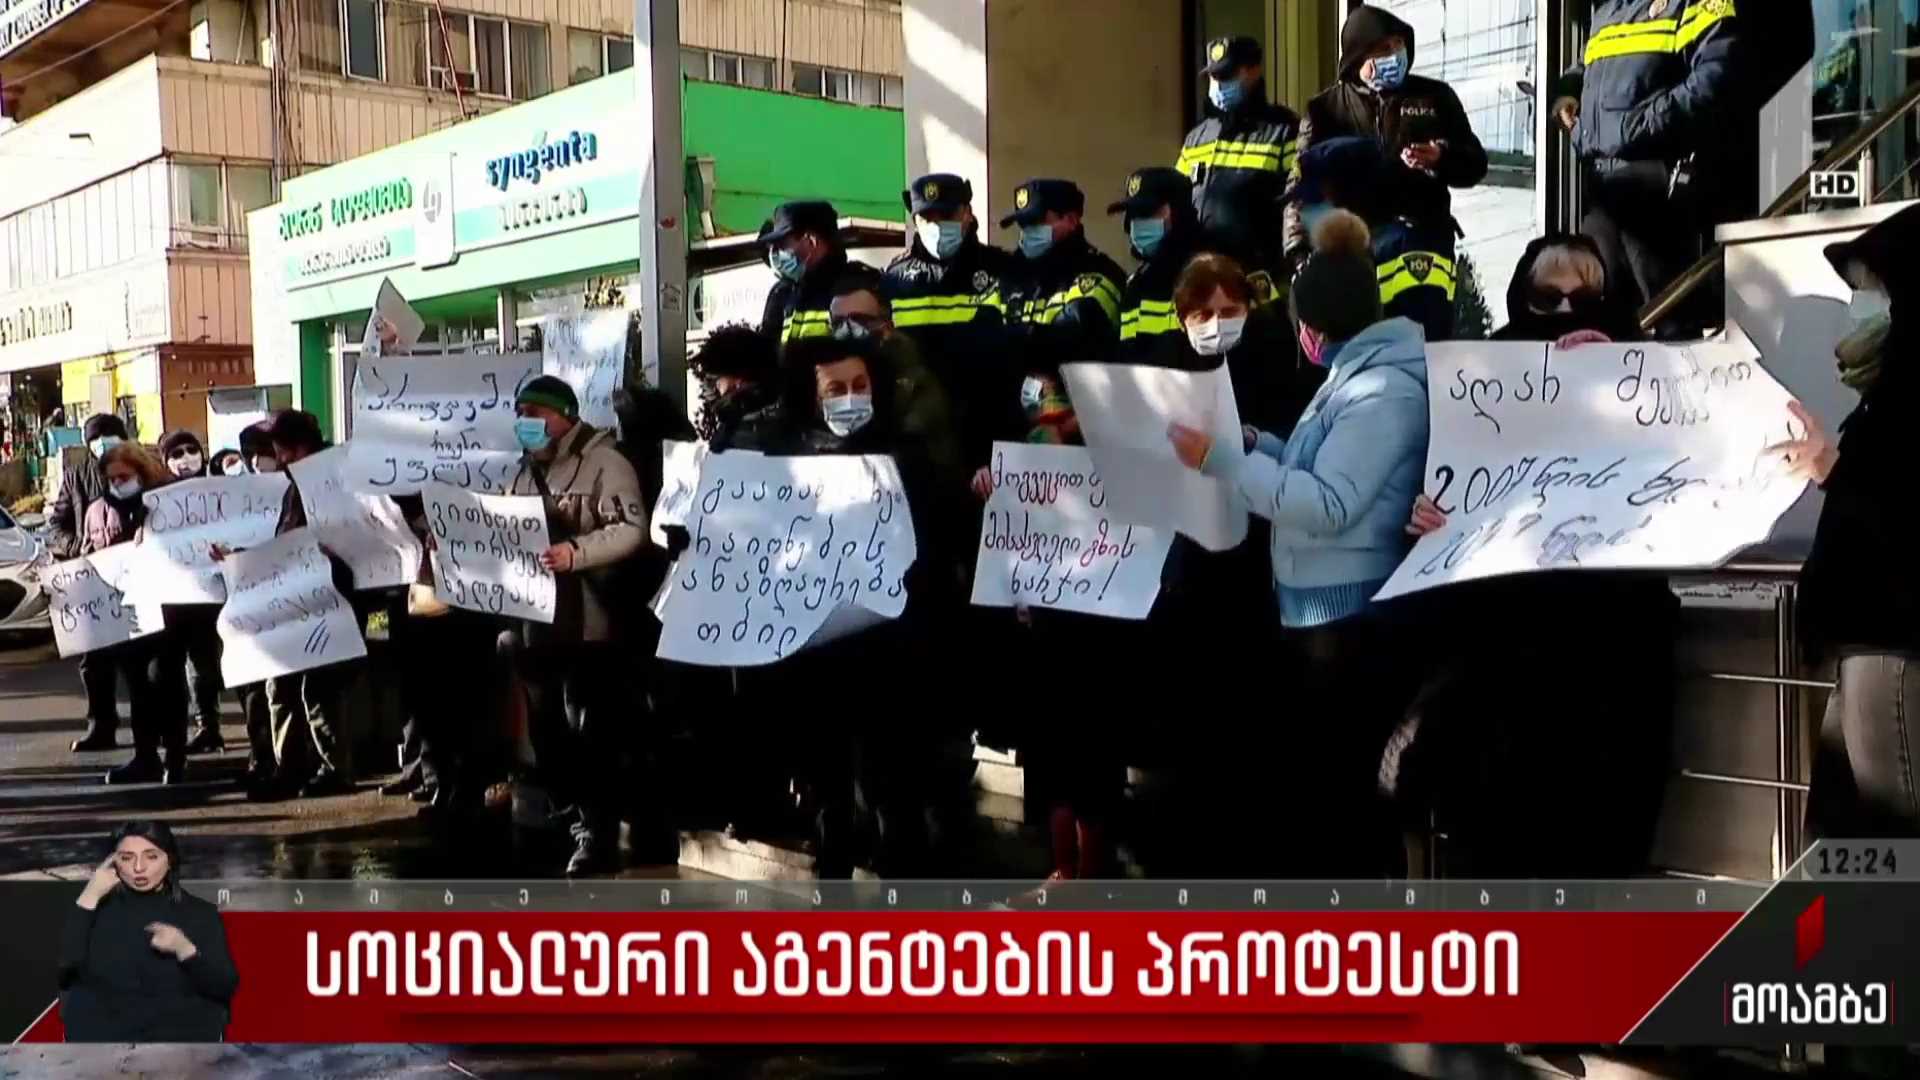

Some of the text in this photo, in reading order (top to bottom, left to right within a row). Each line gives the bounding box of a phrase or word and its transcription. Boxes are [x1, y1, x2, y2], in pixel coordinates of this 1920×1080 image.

[1400, 106, 1435, 116] POLICE
[486, 131, 597, 191] syngenta
[431, 500, 541, 546] ვითხოვთ
[696, 515, 887, 572] რაიონების
[682, 556, 905, 617] ანაზღაურება
